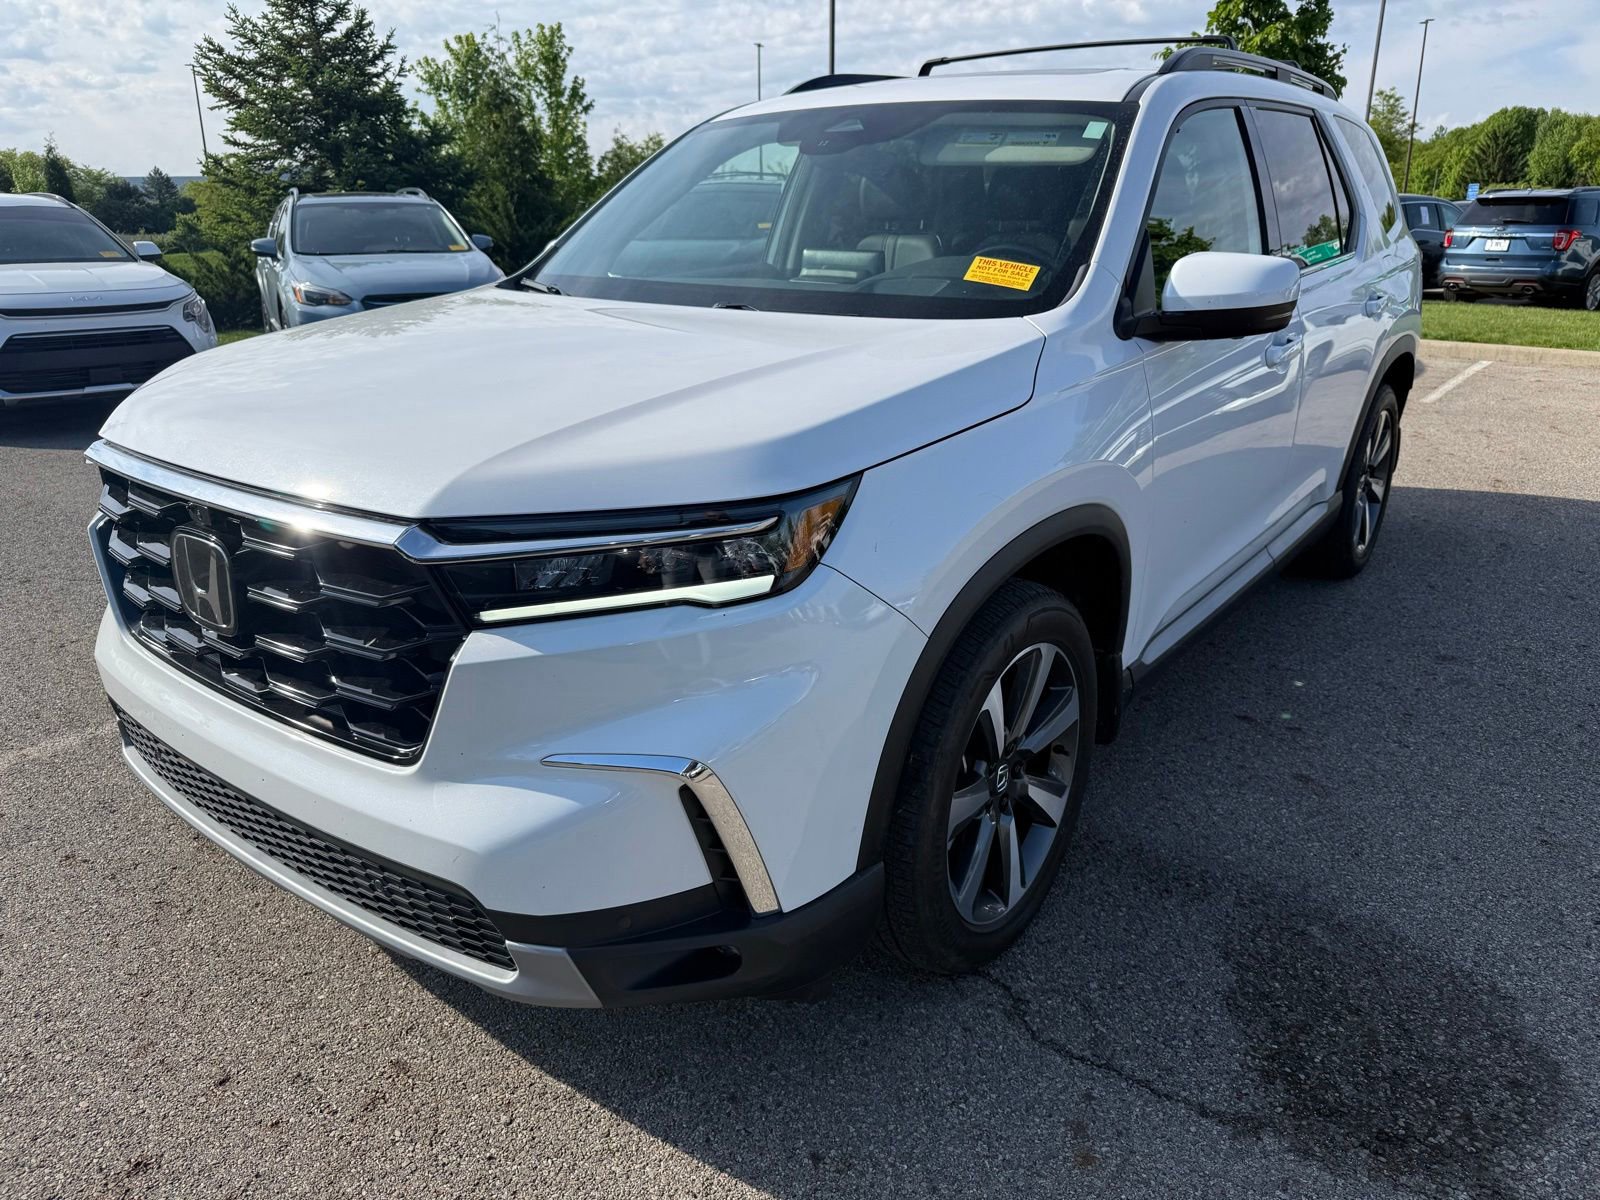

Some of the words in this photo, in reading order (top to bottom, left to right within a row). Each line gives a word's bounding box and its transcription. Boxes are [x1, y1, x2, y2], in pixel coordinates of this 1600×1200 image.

[978, 259, 998, 267] THIS
[999, 261, 1036, 273] VEHICLE
[1010, 270, 1030, 278] SALE
